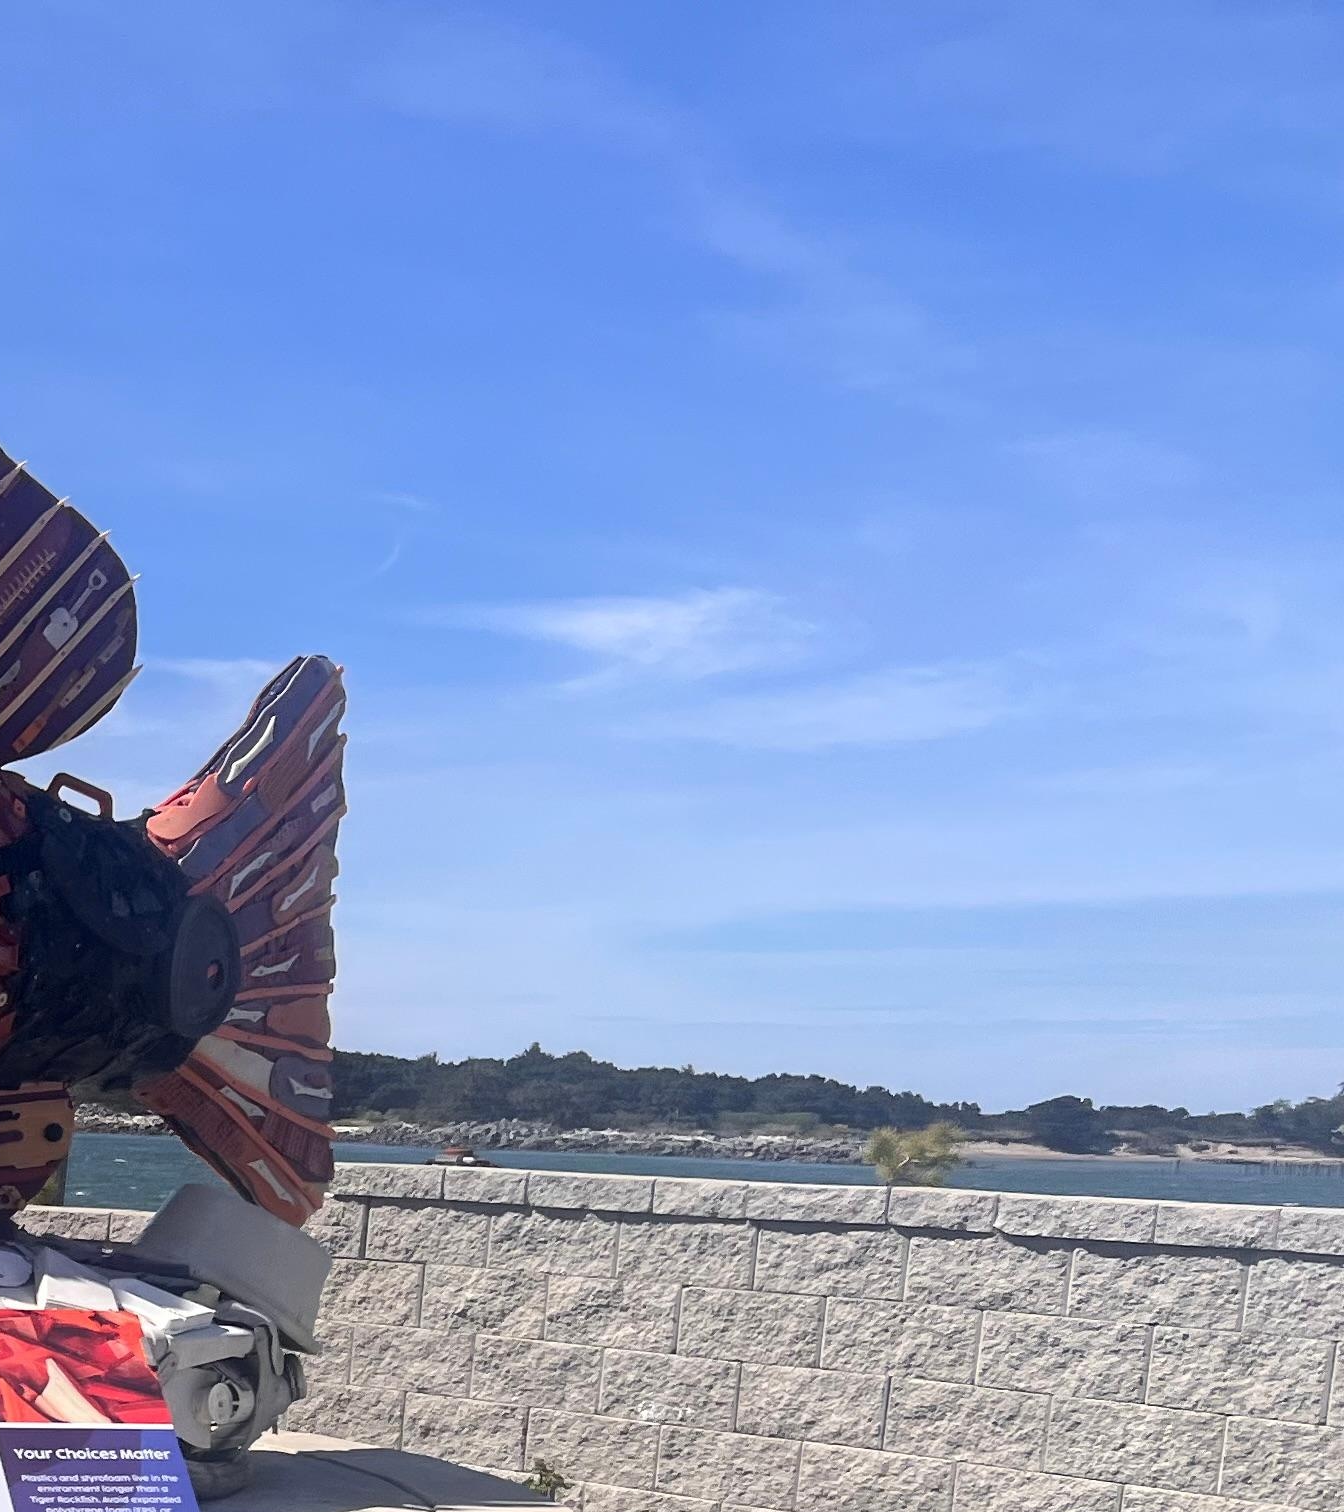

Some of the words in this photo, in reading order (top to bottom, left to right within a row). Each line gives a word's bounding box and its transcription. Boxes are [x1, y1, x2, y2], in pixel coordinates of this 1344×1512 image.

[13, 1448, 53, 1459] Your
[55, 1448, 118, 1460] Choices
[119, 1449, 169, 1460] Matter
[20, 1474, 58, 1482] Plastics
[58, 1474, 80, 1482] and
[80, 1474, 131, 1483] styrofoam
[131, 1474, 149, 1482] live
[150, 1474, 161, 1482] in
[161, 1474, 178, 1482] the
[101, 1485, 134, 1494] longer
[136, 1485, 160, 1493] than
[29, 1496, 55, 1506] Tiger
[102, 1495, 130, 1504] Avoid
[130, 1496, 182, 1504] expanded
